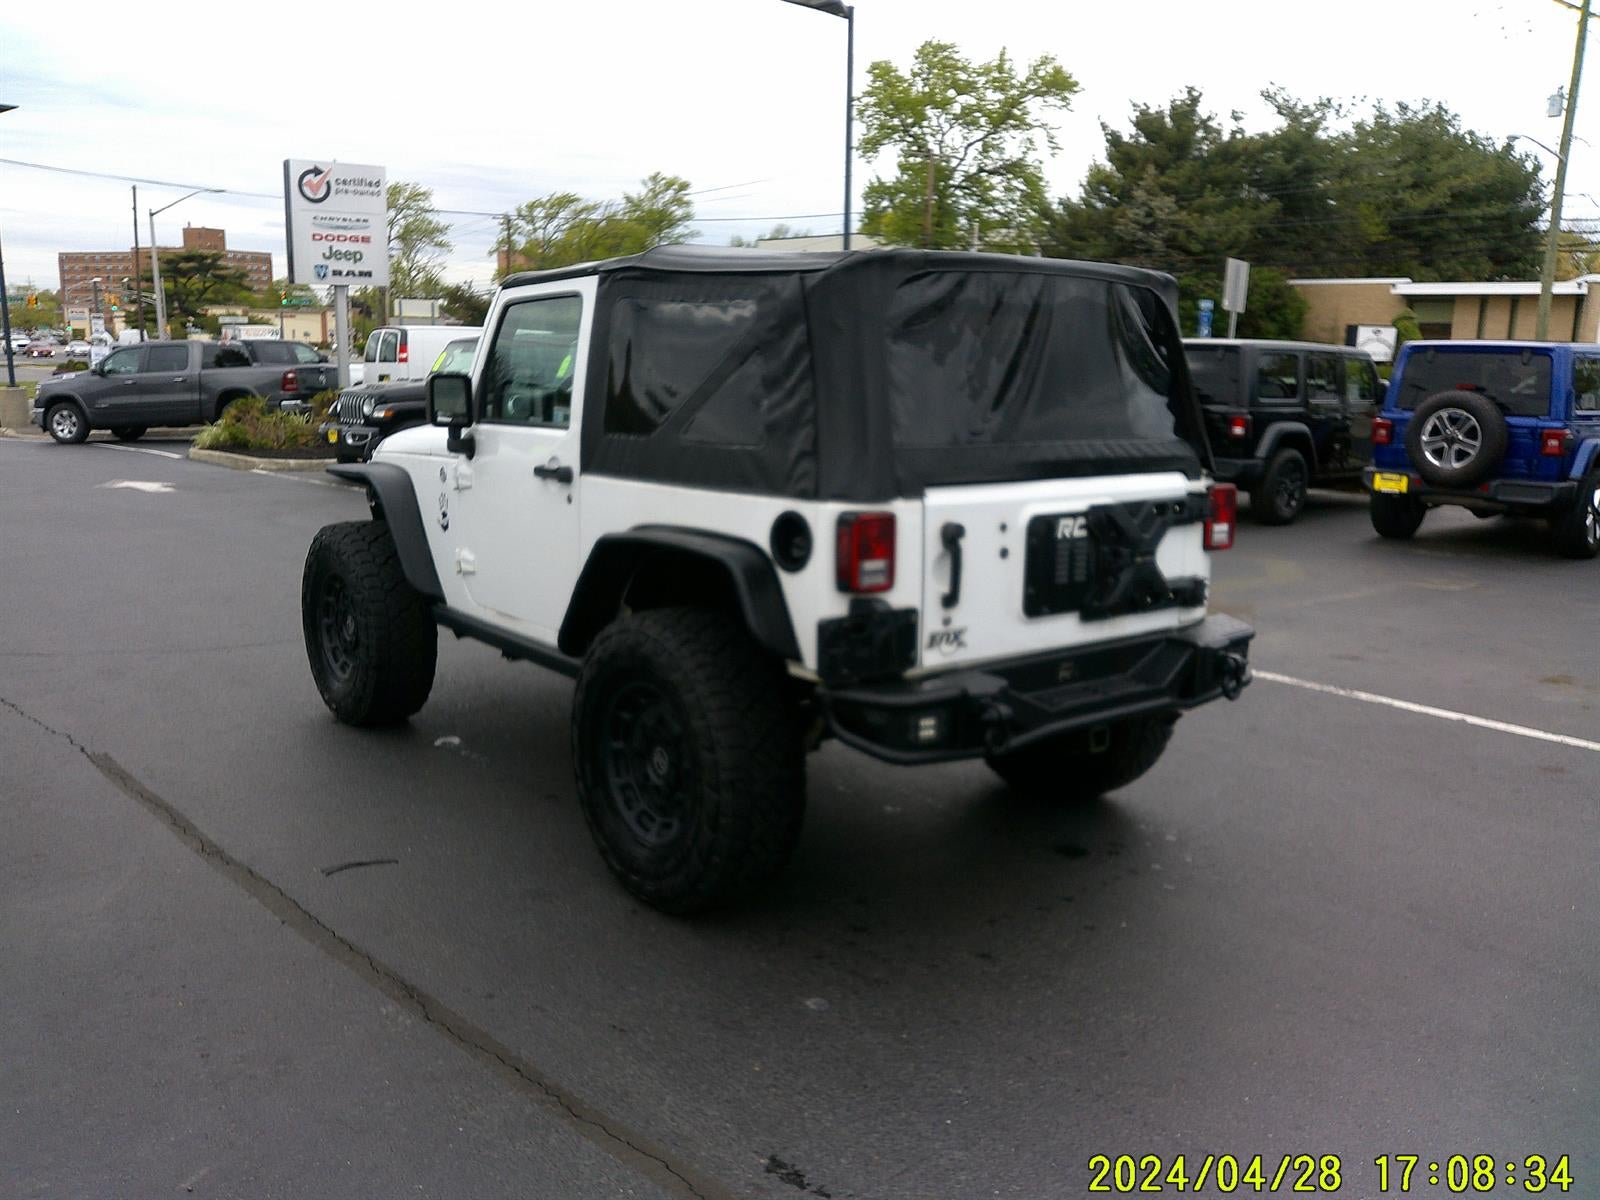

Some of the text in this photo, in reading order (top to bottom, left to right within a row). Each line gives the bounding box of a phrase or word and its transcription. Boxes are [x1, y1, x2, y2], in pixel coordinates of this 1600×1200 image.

[335, 178, 381, 188] certified
[312, 215, 369, 223] CHRYSLER
[312, 232, 371, 243] DODGE
[322, 245, 363, 264] Jeep
[331, 269, 373, 278] RAM
[1057, 515, 1088, 539] RC
